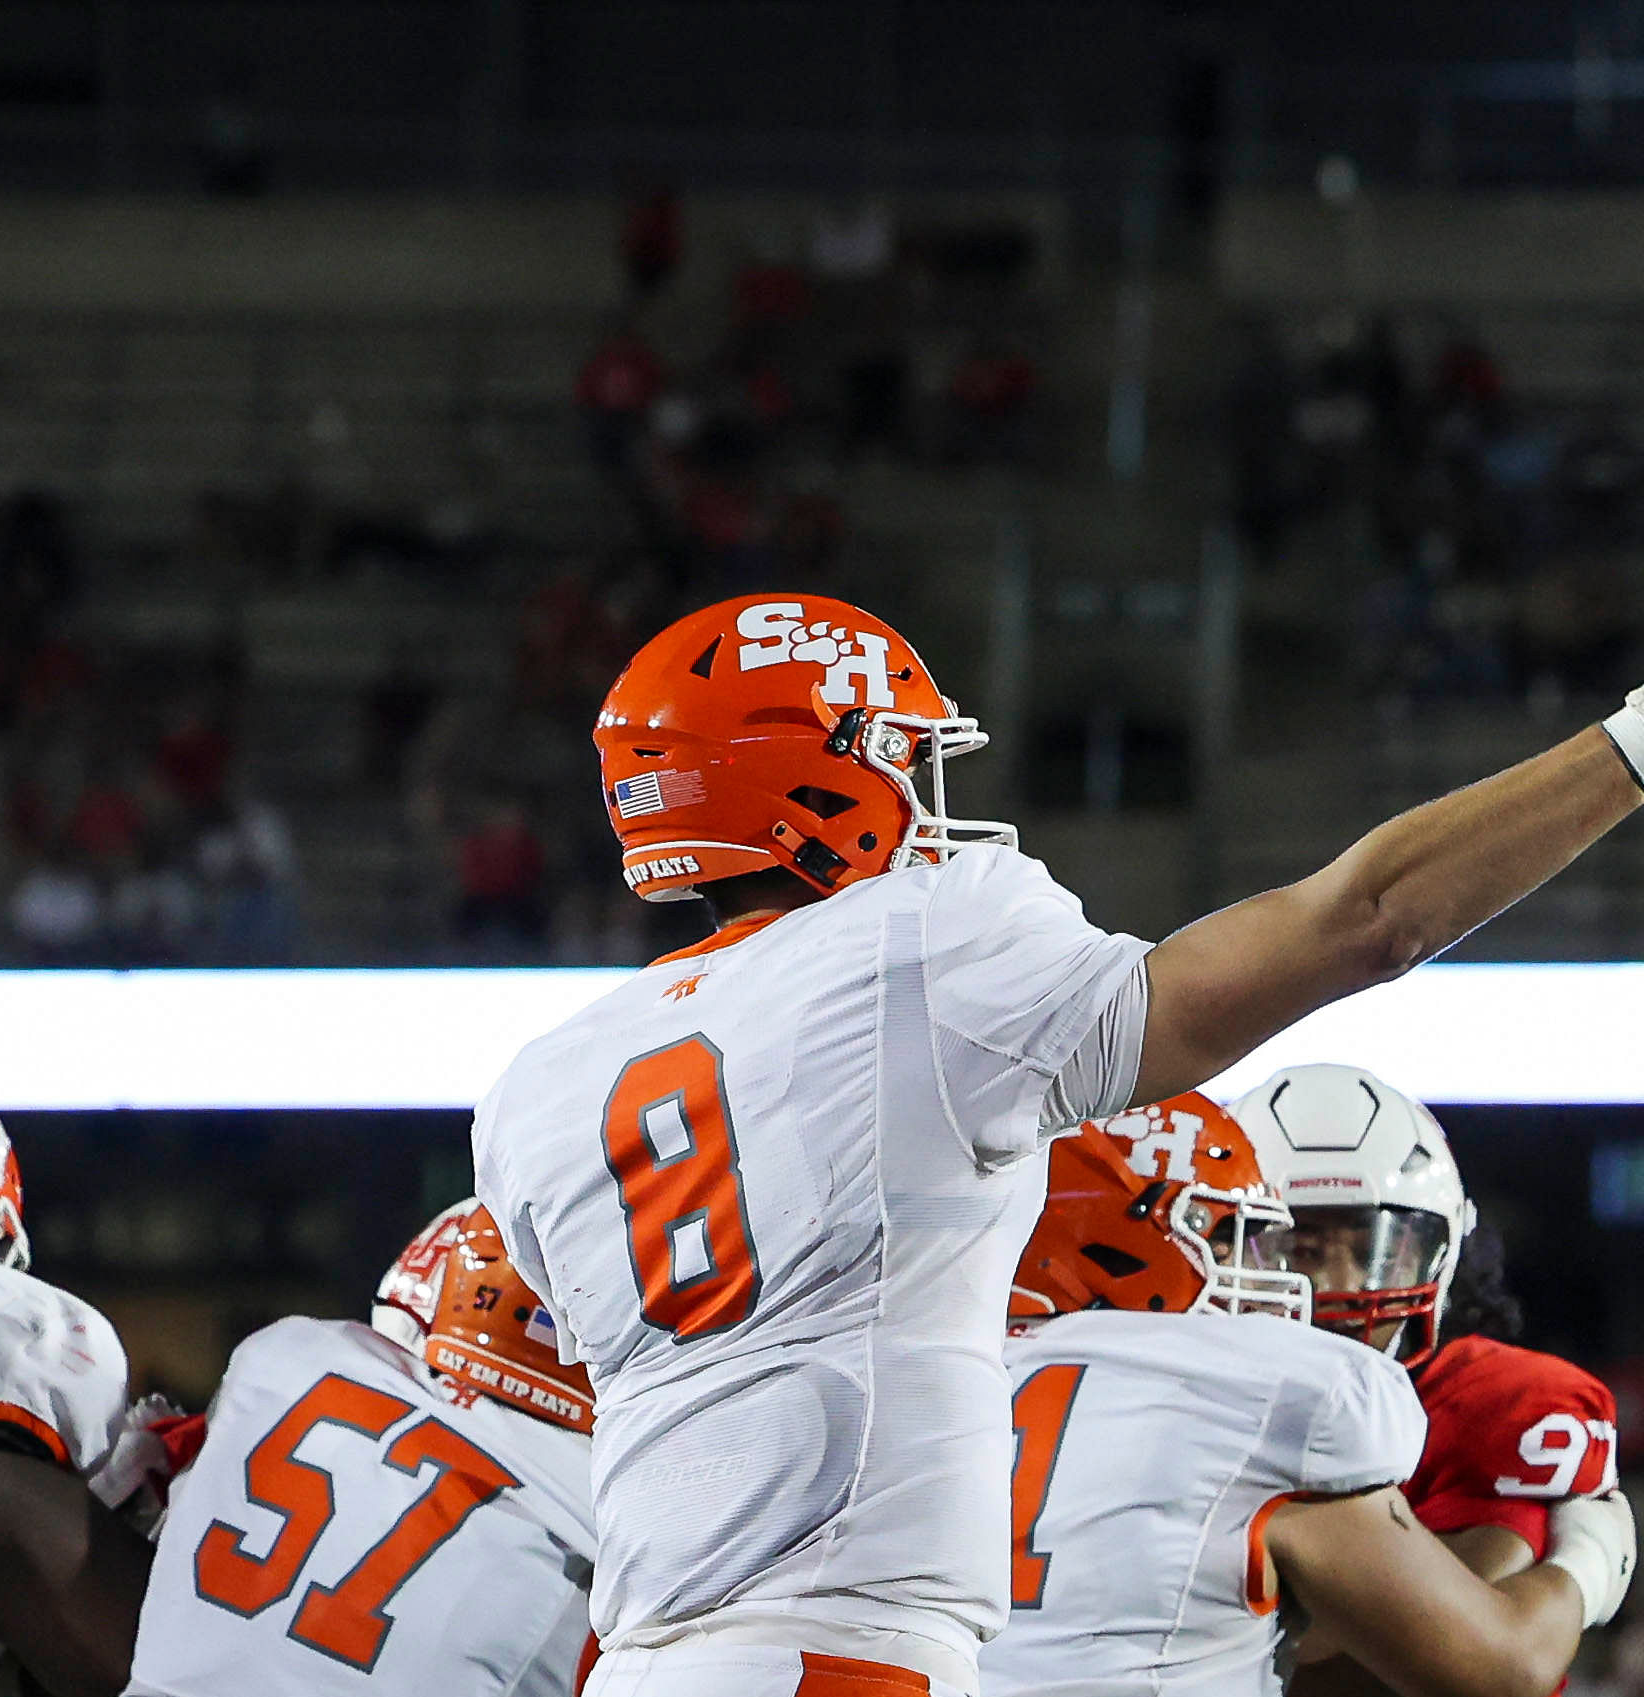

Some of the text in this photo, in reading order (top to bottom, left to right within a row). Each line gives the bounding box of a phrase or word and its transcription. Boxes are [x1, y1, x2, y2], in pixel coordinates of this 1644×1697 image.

[647, 855, 700, 879] KATS
[602, 1031, 763, 1346] 8
[502, 1374, 531, 1399] UP
[194, 1372, 525, 1675] 57
